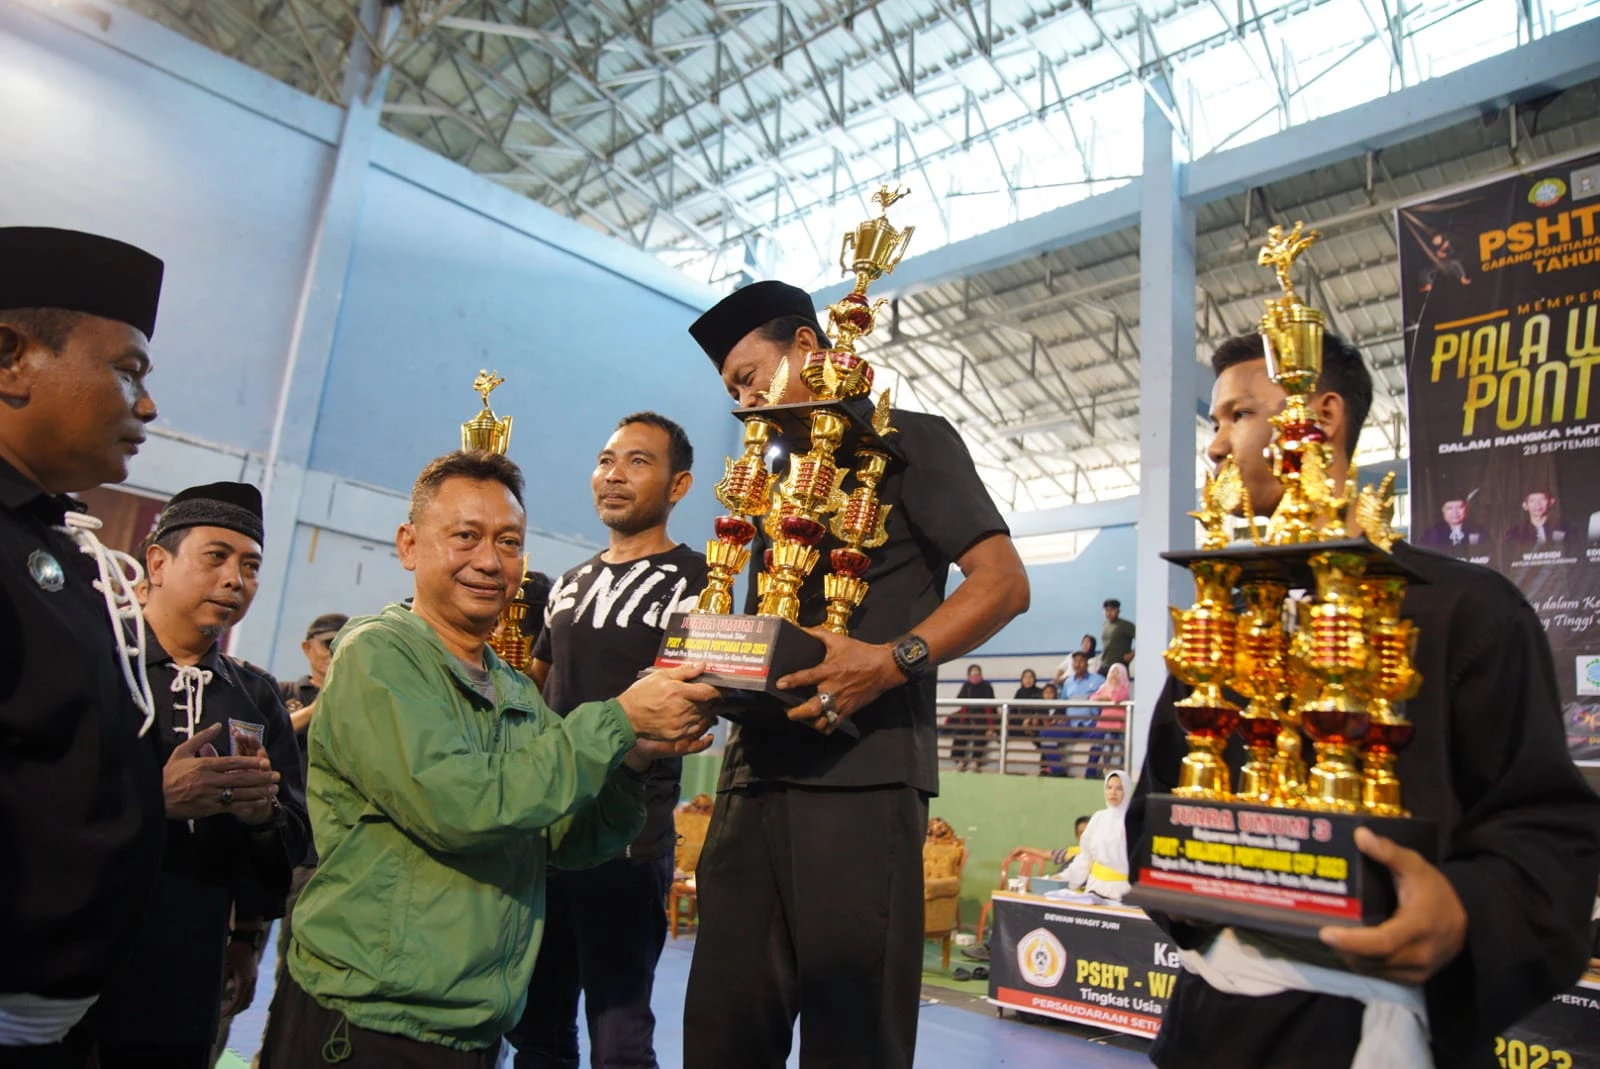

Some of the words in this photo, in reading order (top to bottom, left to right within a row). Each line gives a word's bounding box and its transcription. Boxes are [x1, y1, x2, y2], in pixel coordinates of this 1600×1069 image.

[1479, 204, 1600, 262] PSHT
[1431, 313, 1551, 384] PIALA
[1462, 354, 1600, 437] PONT
[1438, 438, 1491, 454] DALAM
[1494, 428, 1561, 447] RANGKA
[1170, 804, 1235, 831] JUARA
[1237, 811, 1309, 840] UMUM
[1100, 920, 1120, 931] JURI
[1076, 959, 1128, 991] PSHT
[1032, 997, 1129, 1025] PERSAUDARAAN
[1080, 988, 1130, 1009] Tingkat
[1132, 997, 1162, 1014] Usia
